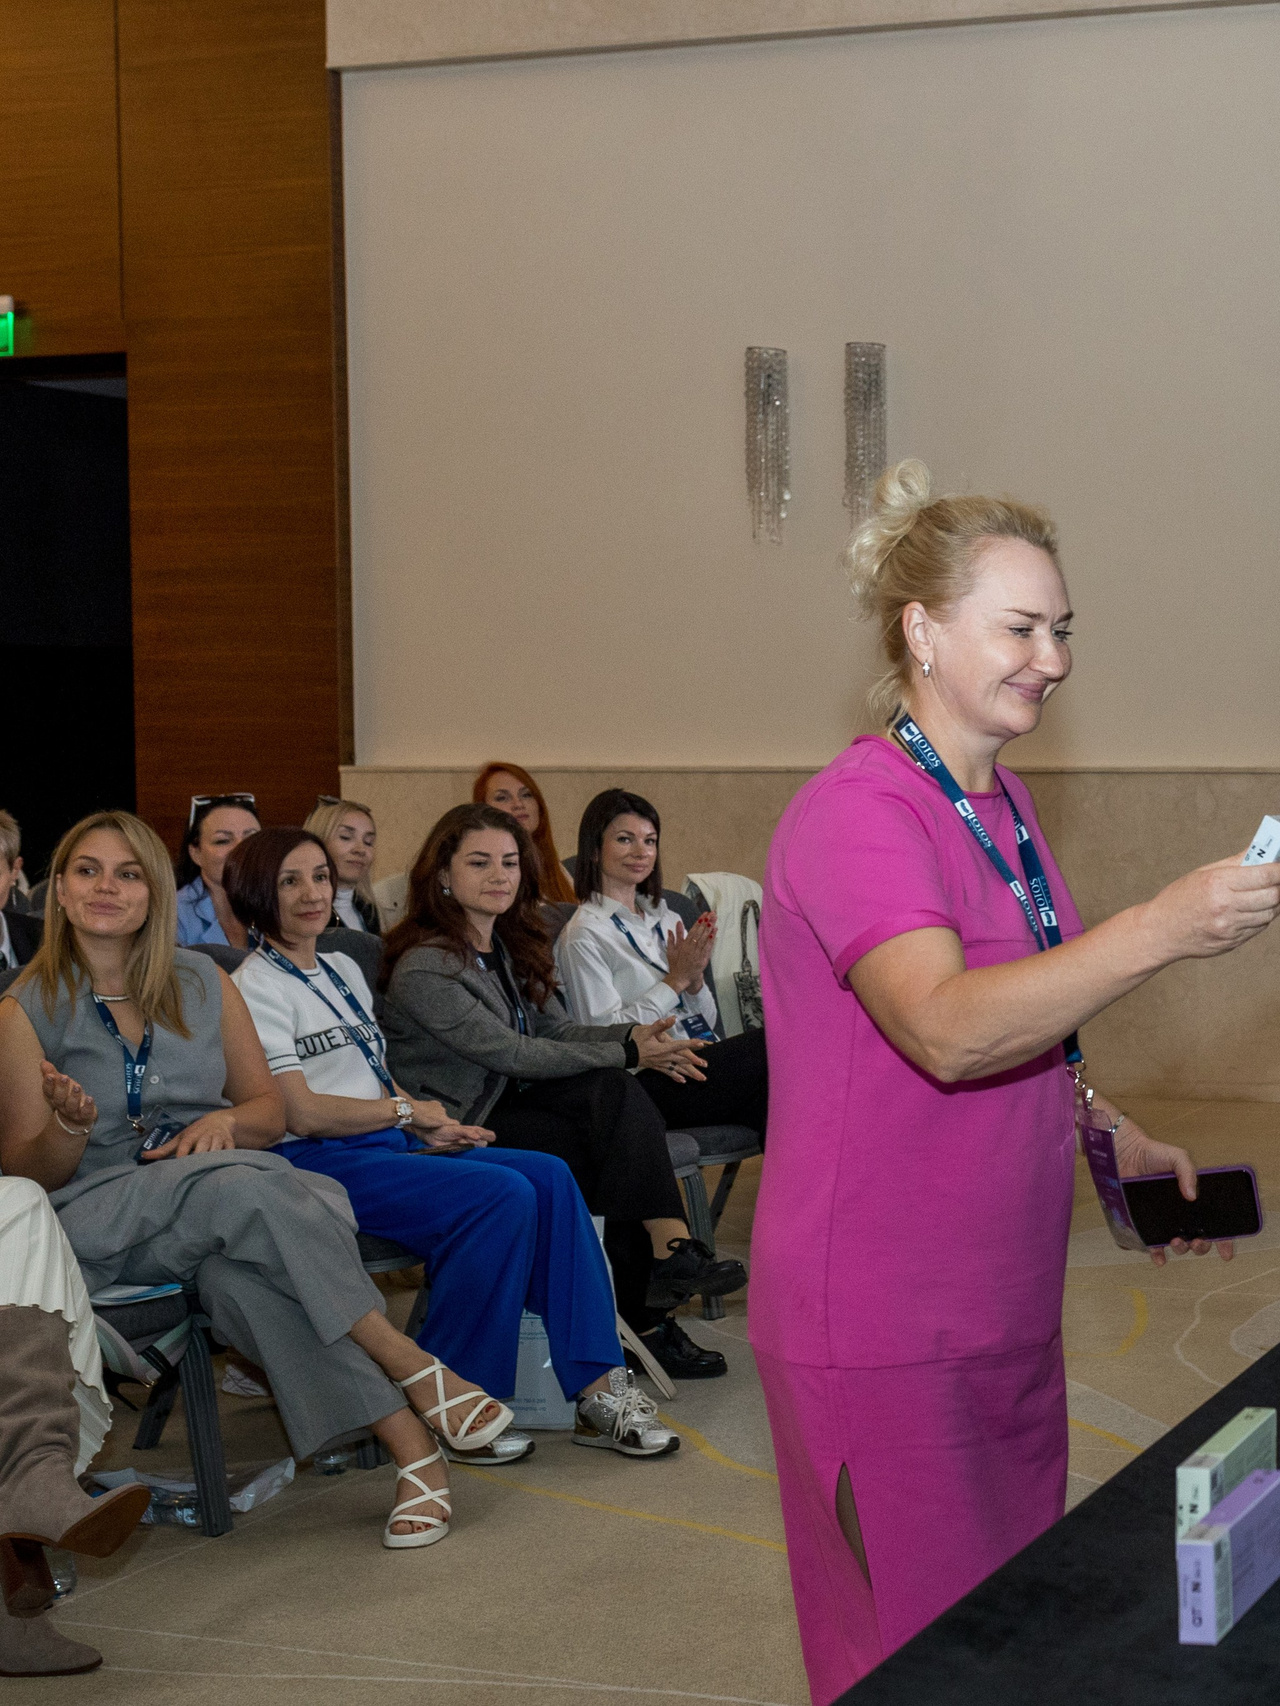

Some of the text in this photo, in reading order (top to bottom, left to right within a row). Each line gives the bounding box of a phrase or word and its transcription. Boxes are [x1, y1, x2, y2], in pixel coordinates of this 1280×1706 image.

[912, 733, 941, 769] LOTOS
[967, 813, 993, 848] LOTOS
[1029, 877, 1050, 913] LOTOS
[295, 1030, 341, 1058] CUTE
